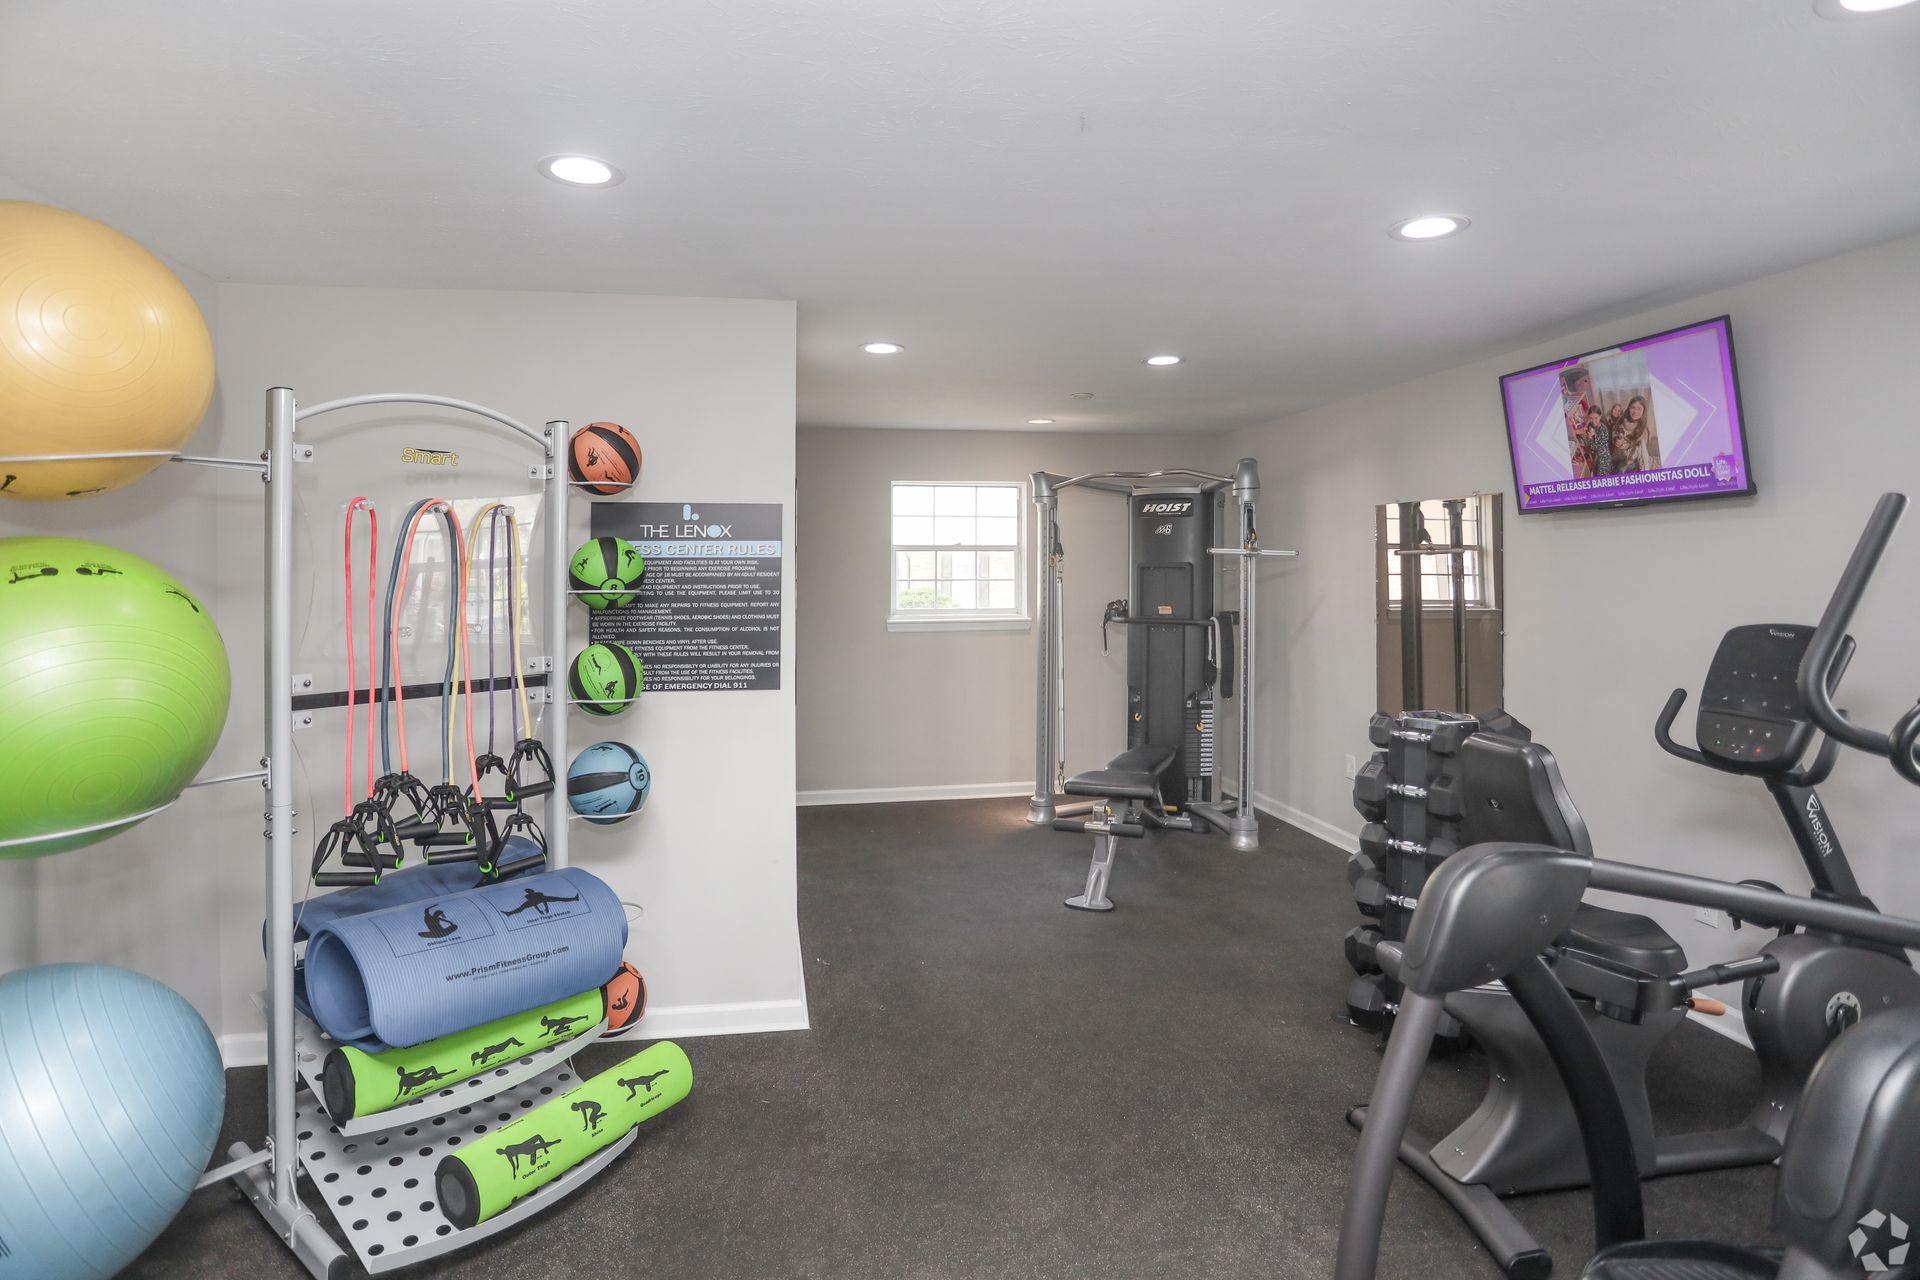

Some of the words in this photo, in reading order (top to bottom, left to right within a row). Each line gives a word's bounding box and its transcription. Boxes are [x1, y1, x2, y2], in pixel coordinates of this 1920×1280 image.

[401, 446, 460, 467] Smart
[1529, 485, 1556, 496] MATTEL
[1556, 480, 1591, 493] RELEASES
[1592, 477, 1620, 488] BARBIE
[1621, 470, 1683, 485] FASHIONISTAS
[1684, 466, 1711, 479] DOLL
[1142, 502, 1192, 513] HOIST
[640, 524, 670, 538] THE
[674, 524, 733, 539] LENOX
[665, 543, 723, 557] CENTER
[728, 543, 776, 557] RULES
[1808, 809, 1833, 855] VISION
[445, 945, 570, 982] www.PrismFitnessGroup.com
[522, 1169, 536, 1180] Outer
[537, 1160, 551, 1171] Thigh
